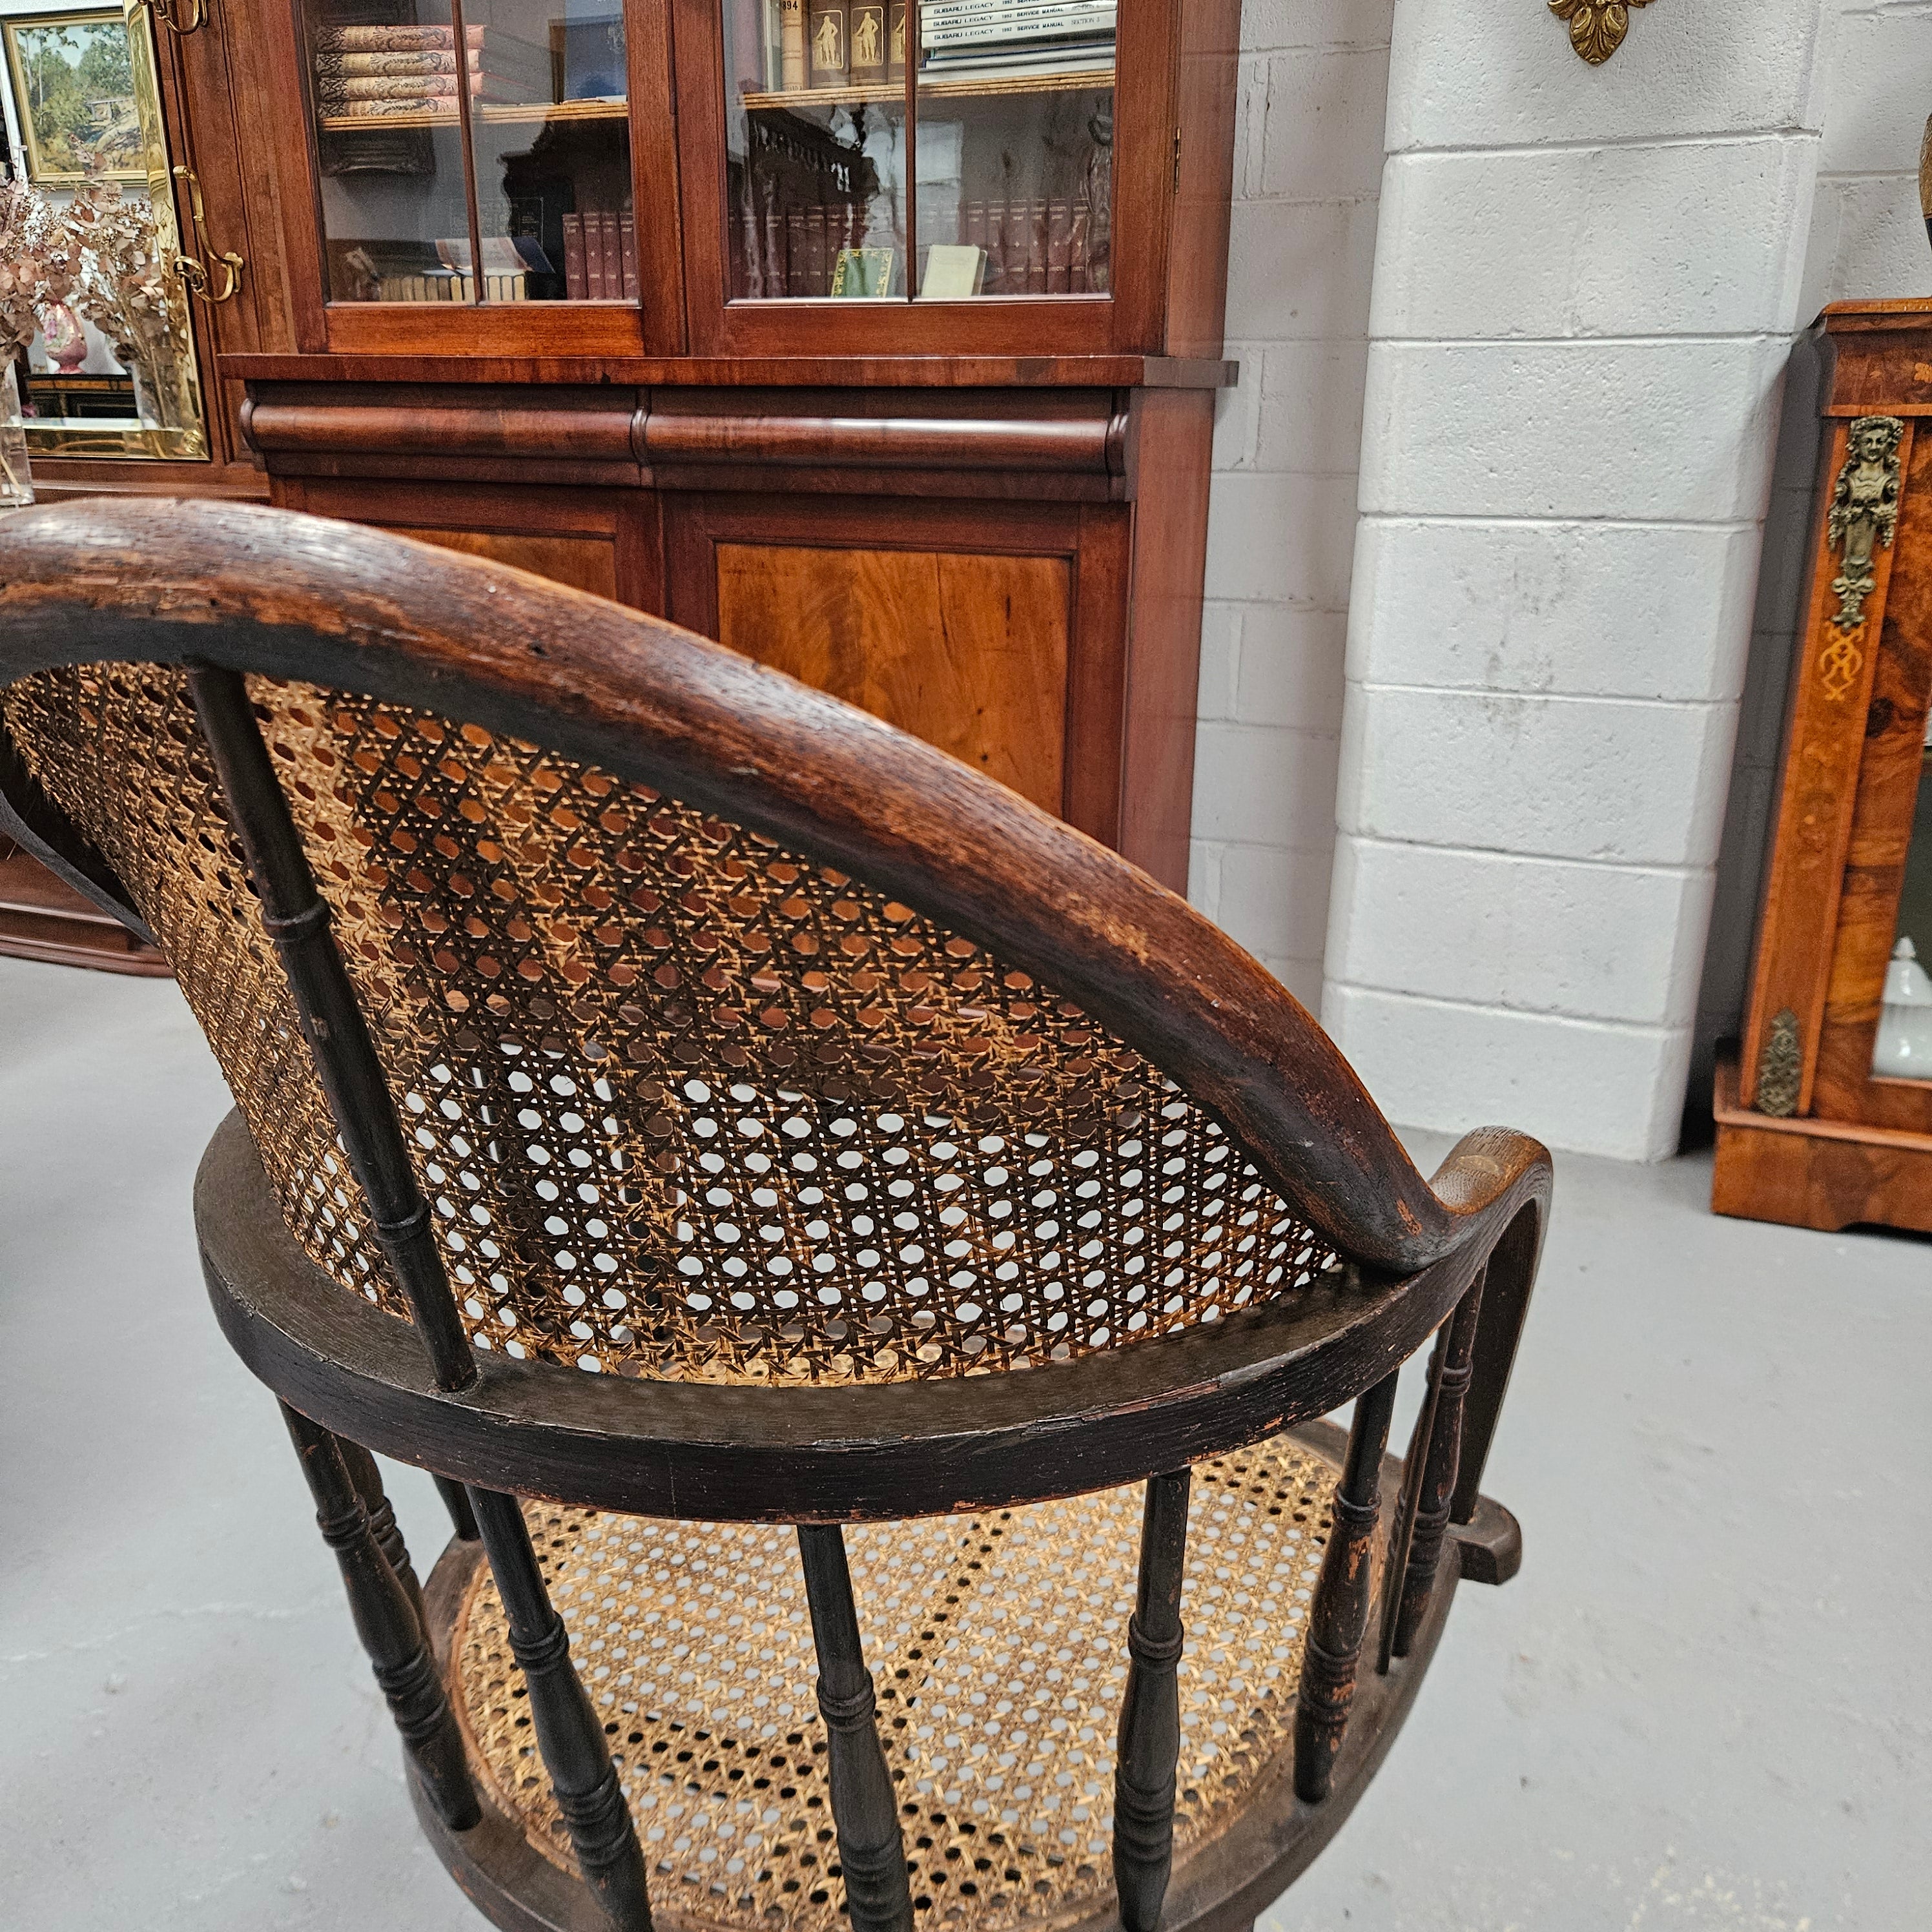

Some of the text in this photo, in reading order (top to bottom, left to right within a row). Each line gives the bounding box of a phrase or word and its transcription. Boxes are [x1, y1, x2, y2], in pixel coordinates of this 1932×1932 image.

[965, 2, 994, 10] LEGACY
[964, 15, 993, 23] LEGACY
[965, 28, 994, 37] LEGACY
